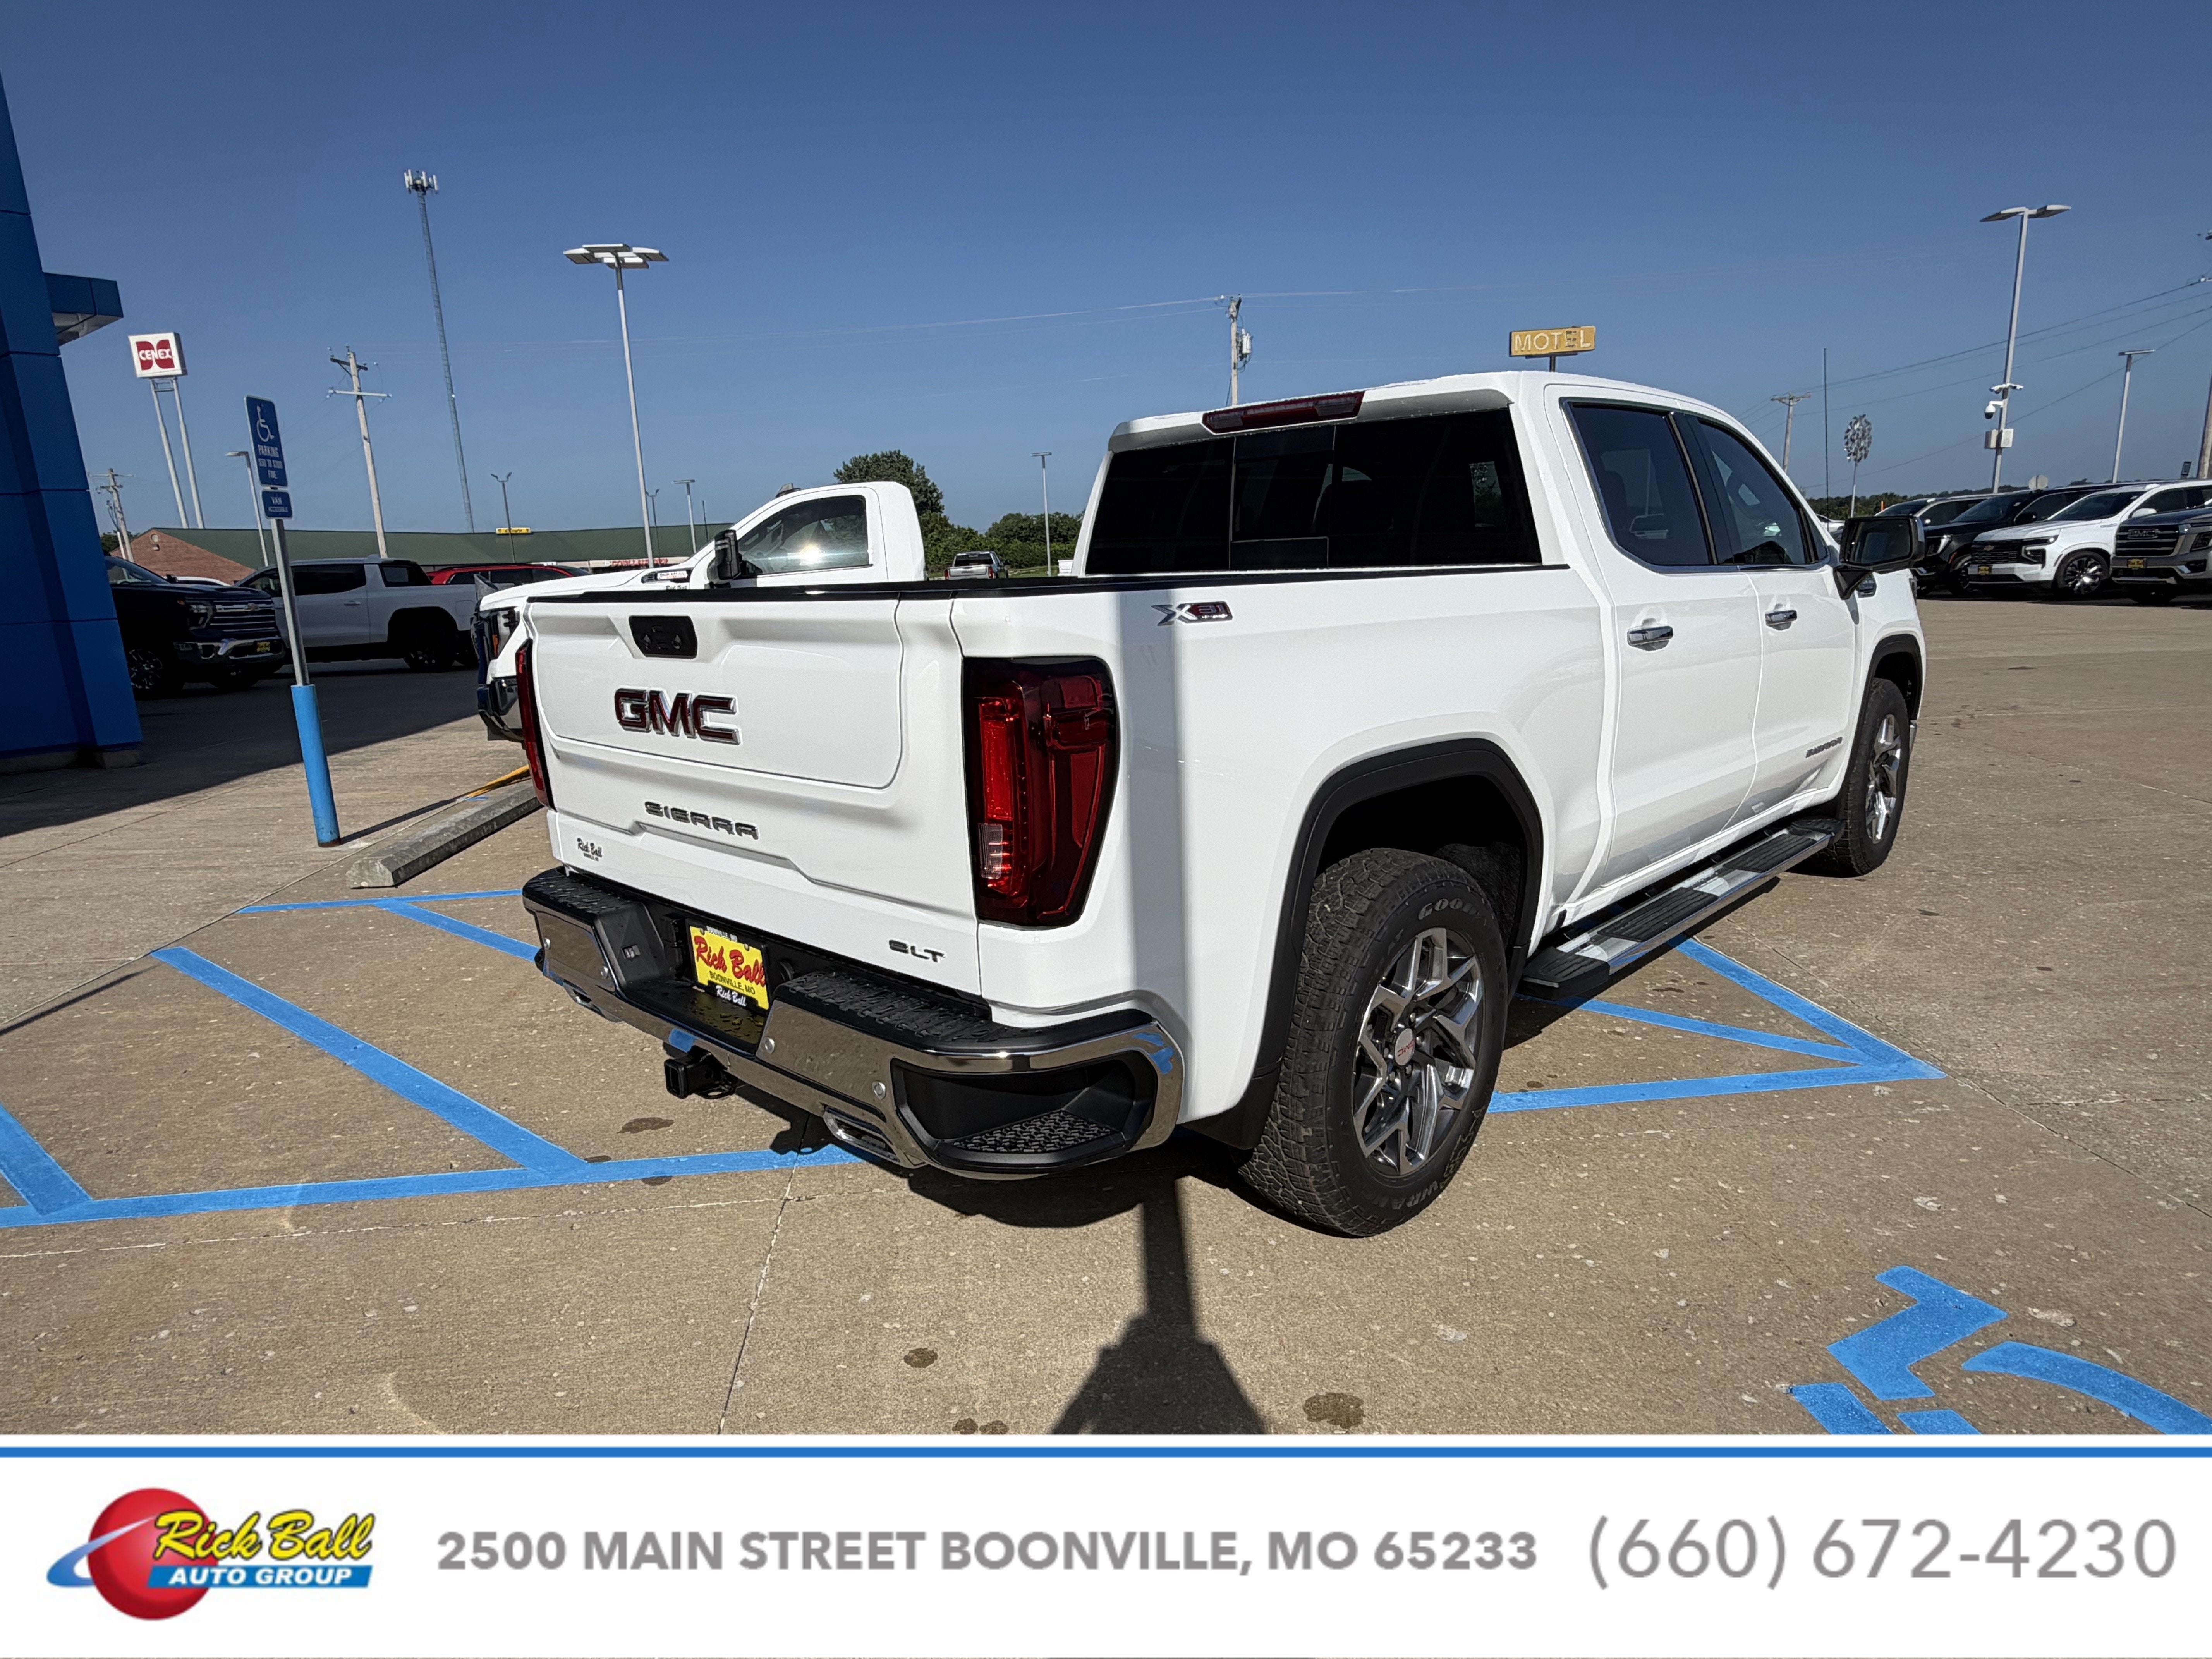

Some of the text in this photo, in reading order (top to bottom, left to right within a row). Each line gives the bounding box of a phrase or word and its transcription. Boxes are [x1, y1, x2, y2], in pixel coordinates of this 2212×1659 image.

[1515, 330, 1592, 352] MOTEL
[139, 349, 173, 361] CENEX
[271, 496, 282, 505] VAN
[1151, 602, 1228, 626] X31
[615, 688, 740, 745] GMC
[644, 801, 759, 840] SIERRA
[577, 838, 590, 853] Rick
[694, 935, 766, 988] Rick Ball
[889, 939, 945, 963] SLT
[716, 984, 747, 1007] Rick Ball
[744, 984, 756, 995] MO
